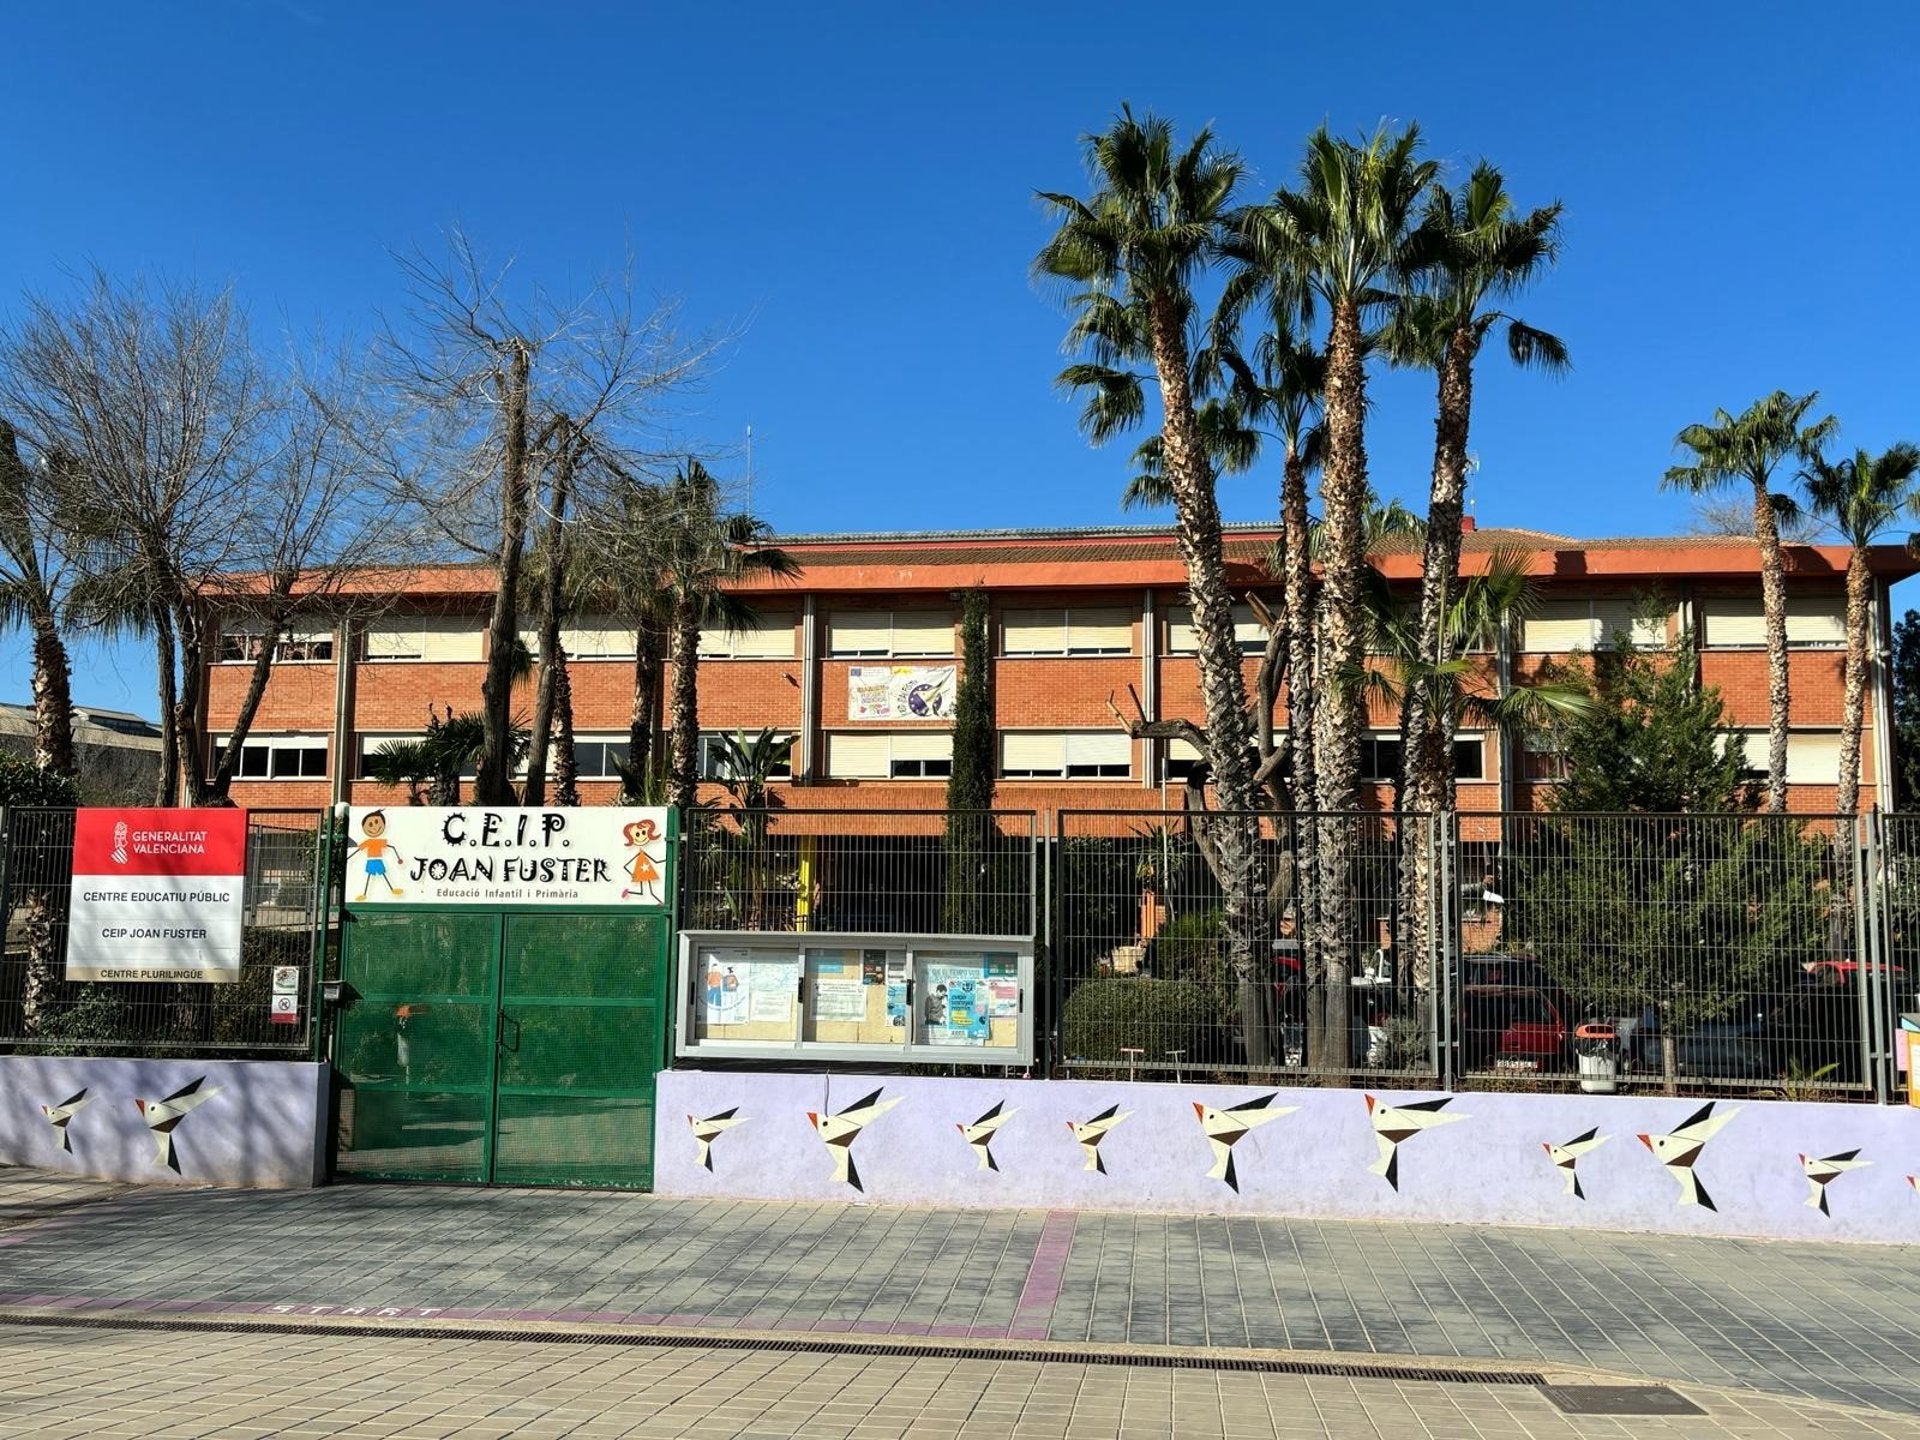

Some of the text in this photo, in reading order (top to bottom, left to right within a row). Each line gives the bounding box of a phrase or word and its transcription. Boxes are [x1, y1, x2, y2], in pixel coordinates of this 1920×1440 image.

[442, 812, 570, 847] C.E.I.P.
[132, 831, 208, 842] GENERALITAT
[133, 844, 205, 854] VALENCIANA
[410, 856, 612, 883] JOAN FUSTER
[83, 890, 230, 903] CENTRE EDUCATIU PÚBLIC
[436, 888, 480, 898] Educació
[485, 889, 522, 899] Infantil
[535, 889, 578, 899] Primària
[102, 929, 207, 939] CEIP JOAN FUSTER
[100, 969, 203, 980] CENTRE PLURILINGÜE
